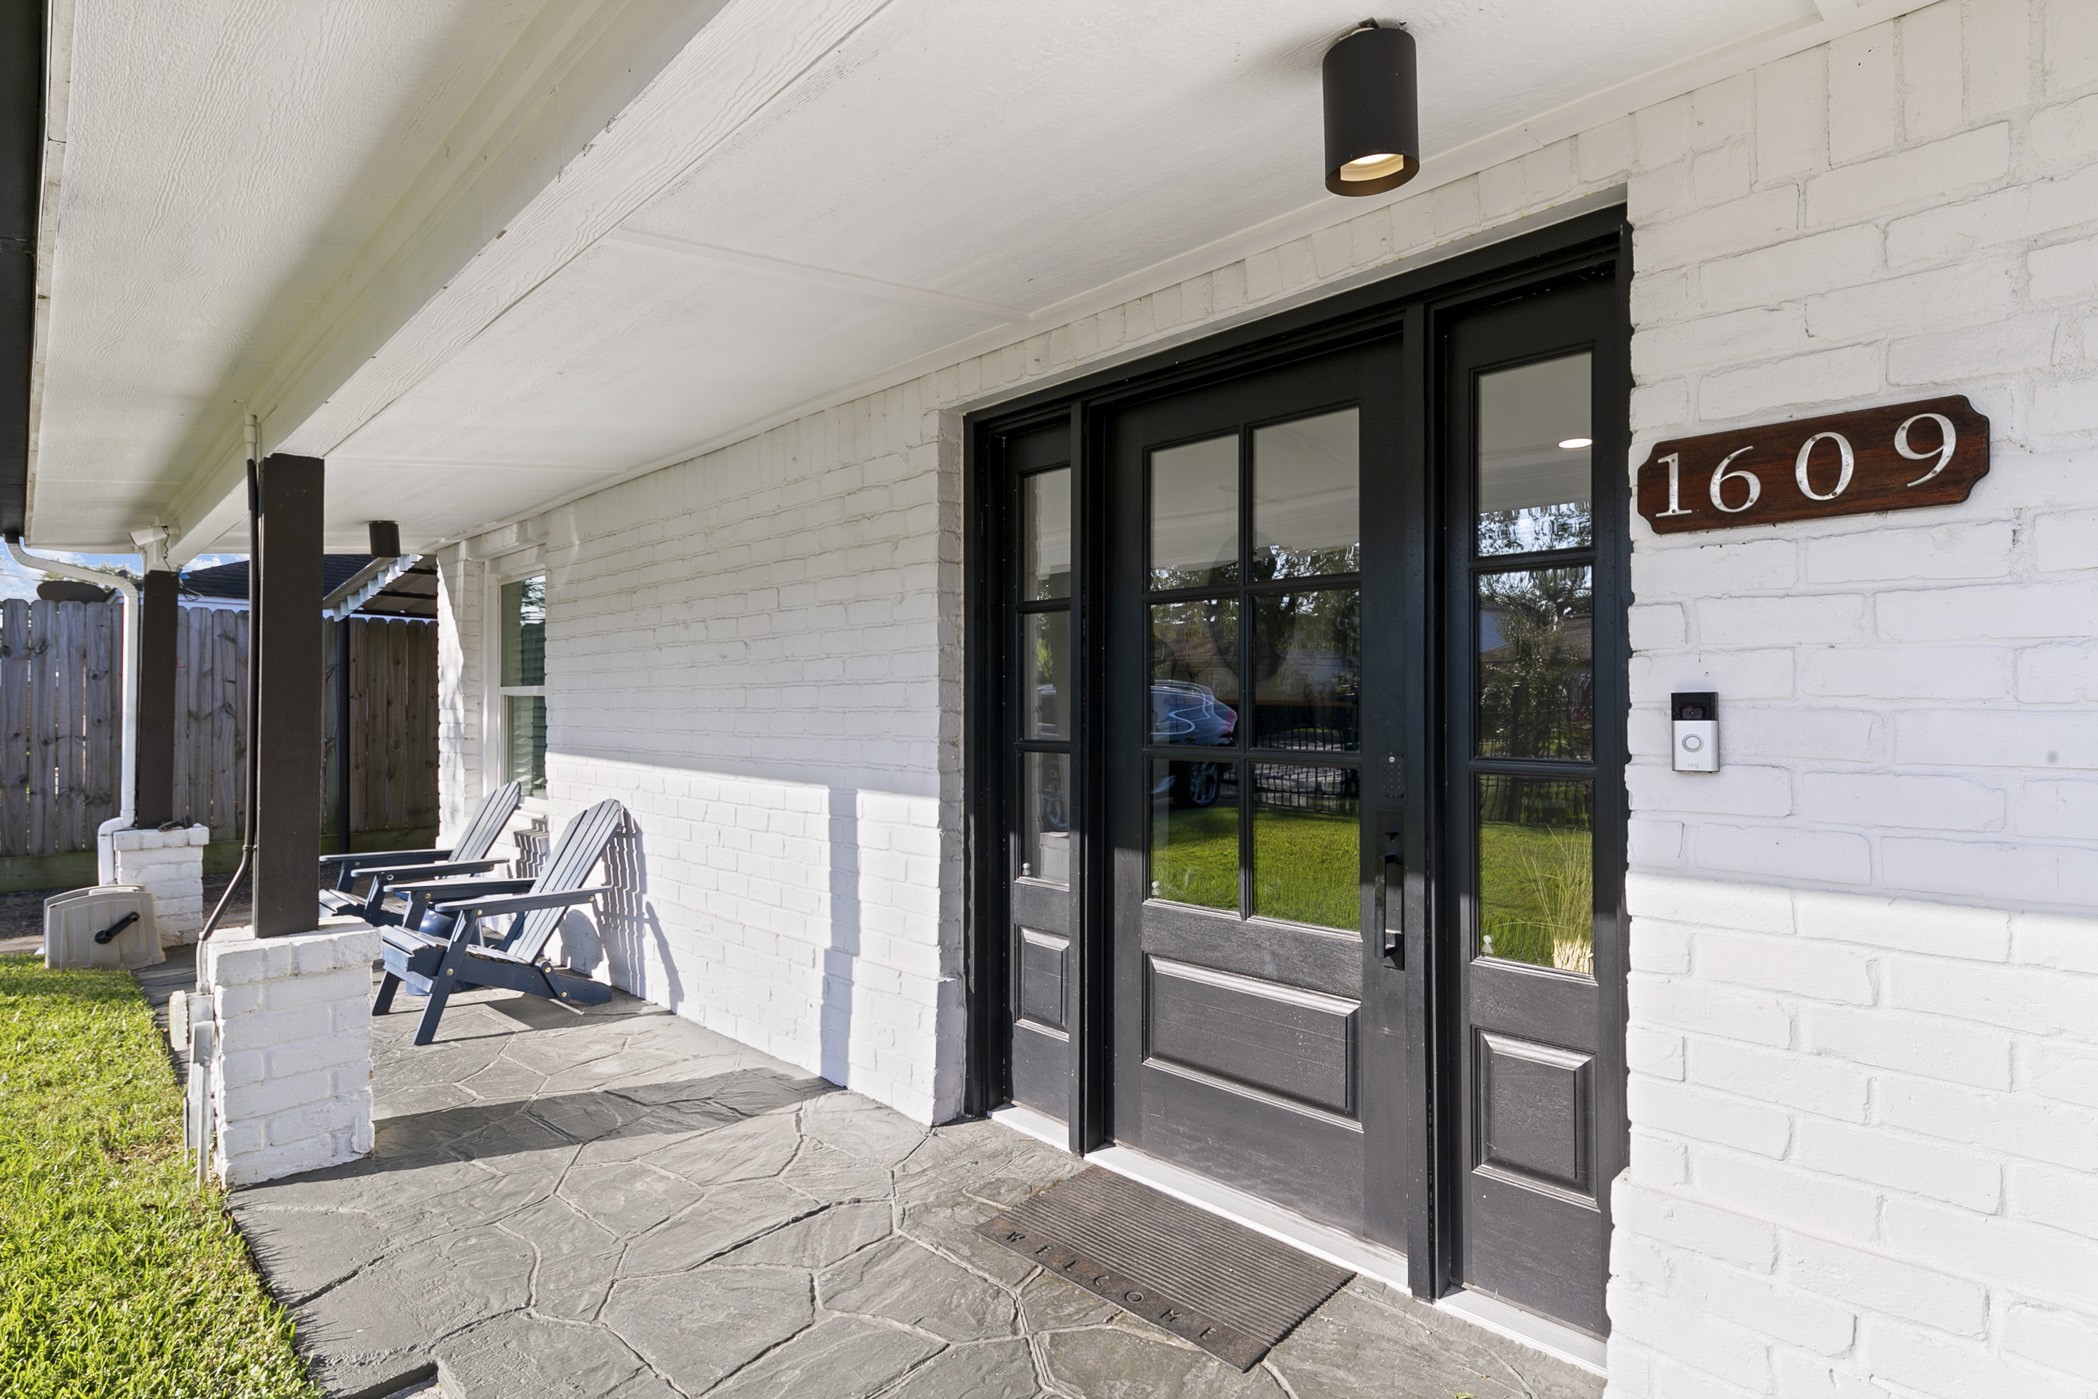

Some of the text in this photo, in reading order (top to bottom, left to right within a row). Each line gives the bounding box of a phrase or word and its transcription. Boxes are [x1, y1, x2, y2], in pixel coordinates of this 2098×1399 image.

[1655, 412, 1957, 518] 1609
[1687, 761, 1700, 769] ring
[1005, 1231, 1217, 1341] WELCOME
